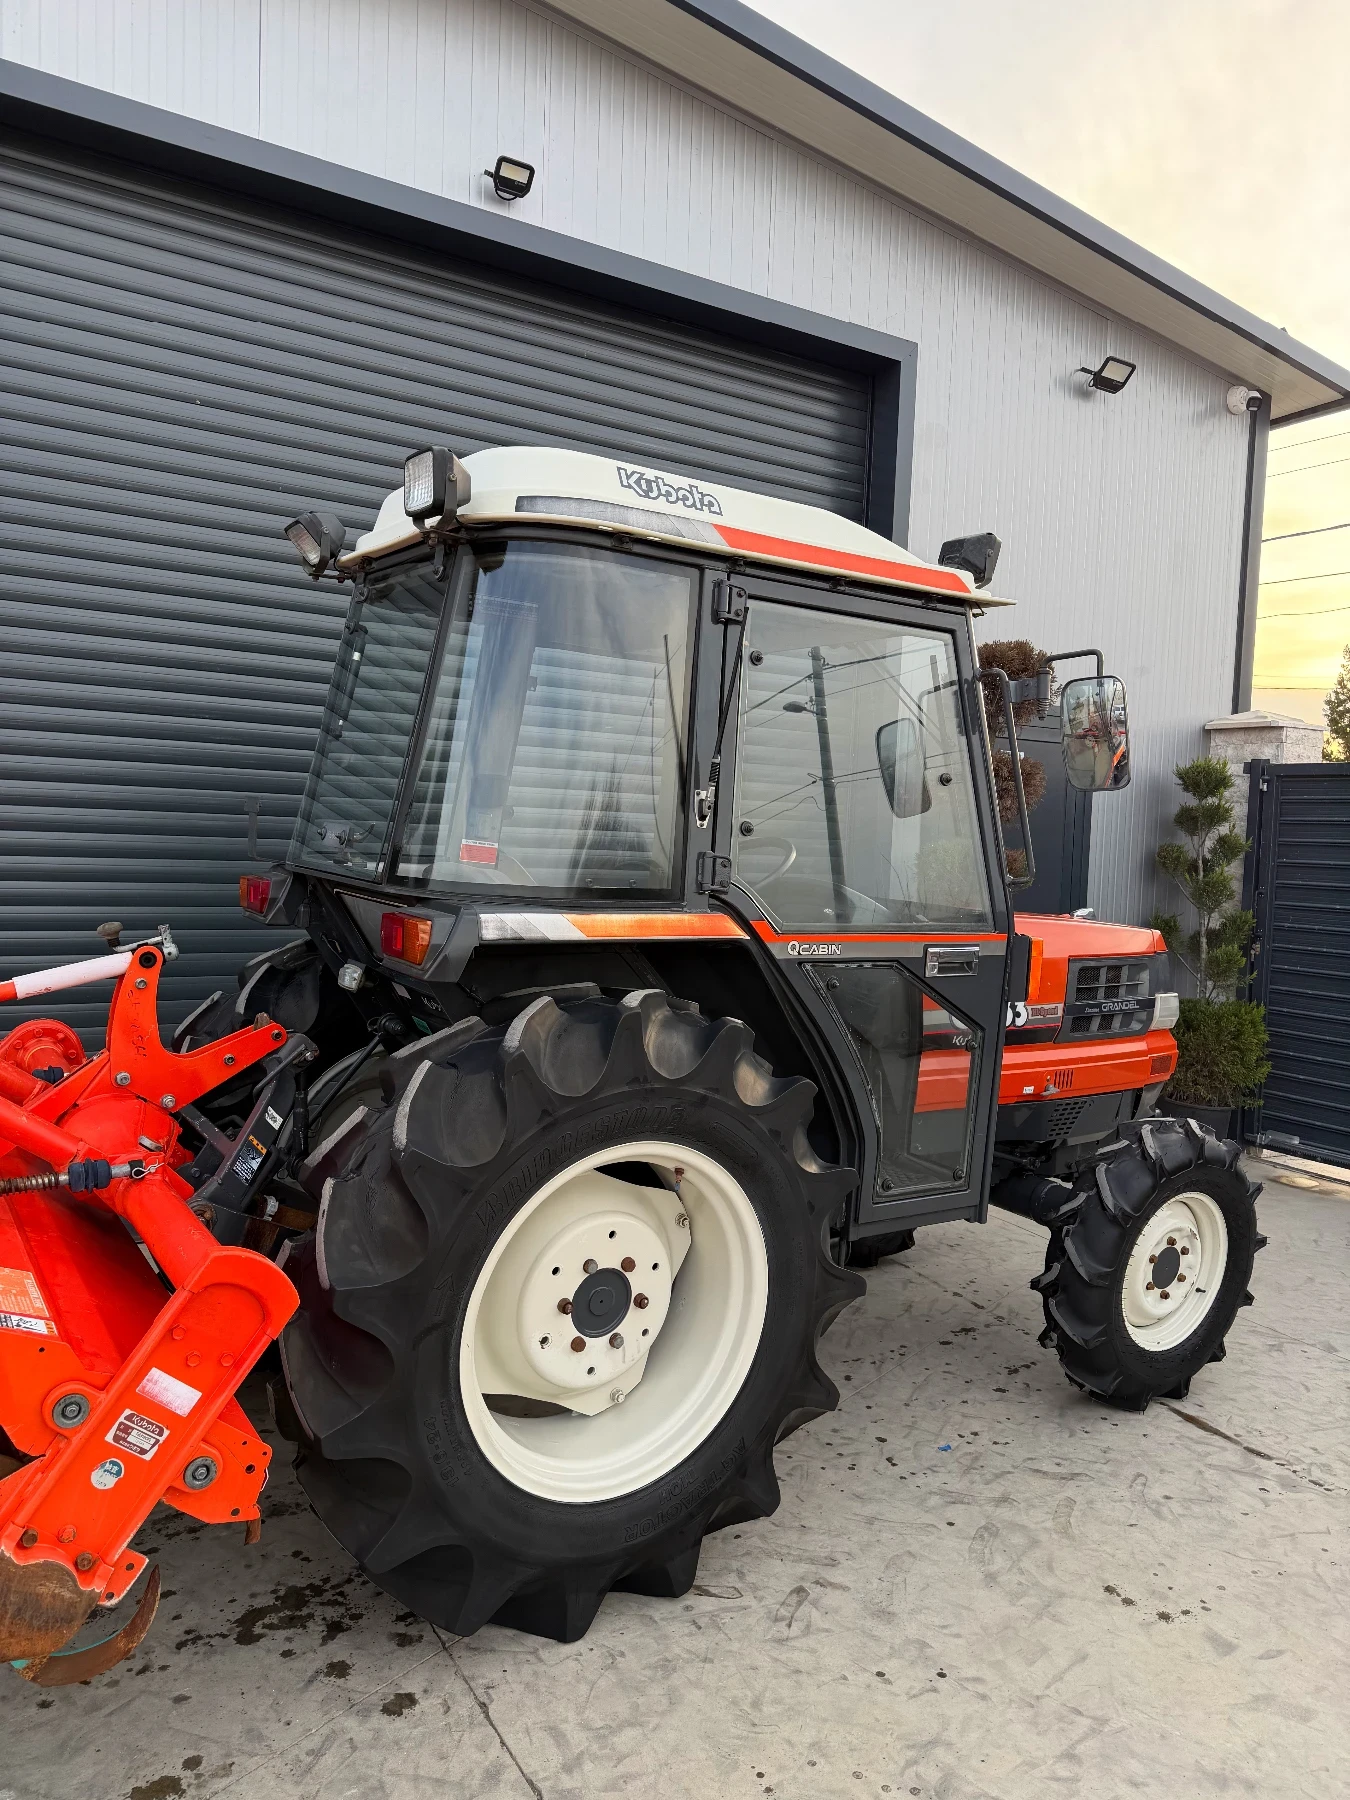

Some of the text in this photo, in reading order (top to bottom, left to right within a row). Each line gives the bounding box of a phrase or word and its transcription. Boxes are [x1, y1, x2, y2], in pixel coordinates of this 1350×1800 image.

[615, 465, 723, 516] Kubota
[1101, 1000, 1140, 1011] GRANDEL
[131, 1414, 161, 1435] Kubota
[623, 1469, 722, 1543] TRACTOR
